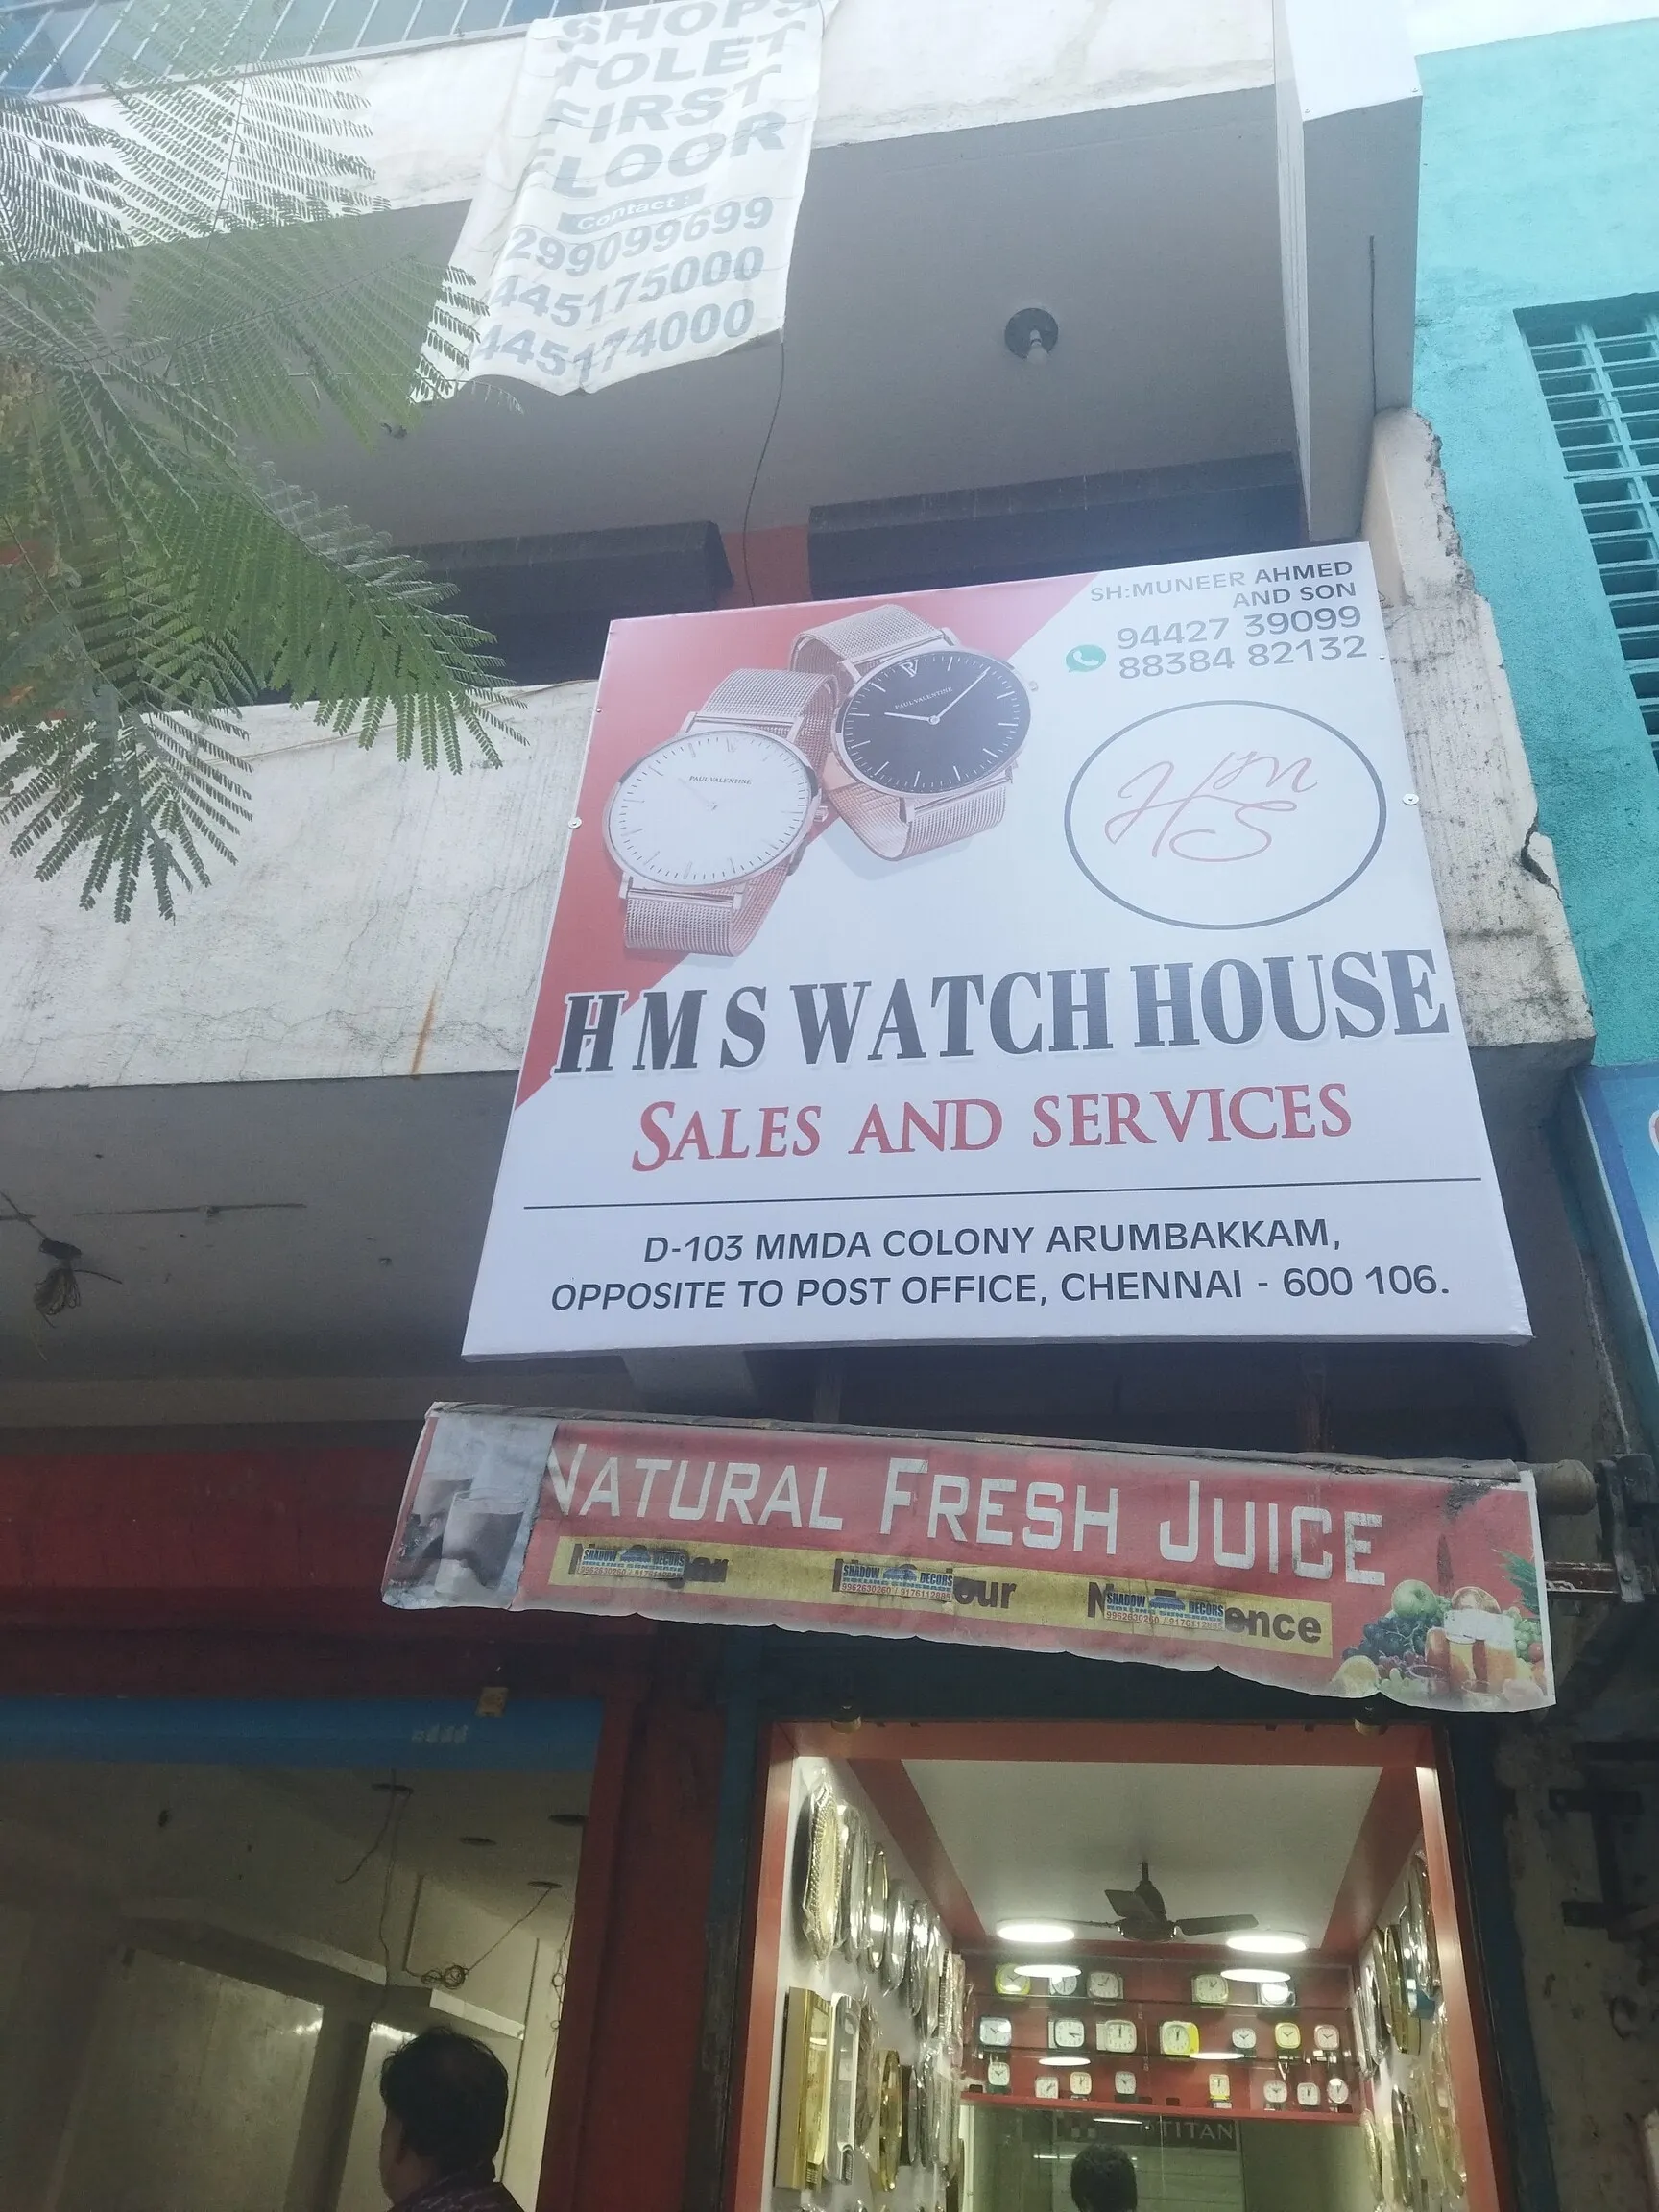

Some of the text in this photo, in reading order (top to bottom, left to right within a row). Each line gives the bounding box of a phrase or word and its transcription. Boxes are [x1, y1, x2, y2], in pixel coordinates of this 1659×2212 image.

[554, 19, 805, 91] TOLET
[540, 63, 782, 144] FIRST
[577, 196, 675, 230] Contact
[1254, 560, 1354, 585] AHMED
[1232, 582, 1357, 609] AND SON
[1116, 605, 1362, 650] 94427 39099
[1118, 634, 1368, 680] 88384 82132
[789, 966, 1114, 1066] WATCH
[1129, 948, 1450, 1048] HOUSE
[631, 1082, 1353, 1172] SALES AND SERVICES
[643, 1218, 1341, 1263] D-103 MMDA COLONY ARUMBAKKAM,
[550, 1281, 726, 1311] OPPOSITE
[737, 1279, 784, 1308] TO
[796, 1276, 892, 1307] POST
[902, 1272, 1048, 1307] OFFICE,
[1060, 1269, 1242, 1303] CHENNAI
[1282, 1266, 1354, 1298] 600
[1363, 1264, 1450, 1296] 106.
[878, 1456, 1119, 1555] FRESH
[1159, 1479, 1386, 1587] JUICE
[843, 1565, 880, 1578] SHADOW
[920, 1572, 953, 1587] DECORS
[1106, 1592, 1224, 1617] SHADOW DECORS
[1157, 2120, 1234, 2140] TITAN
